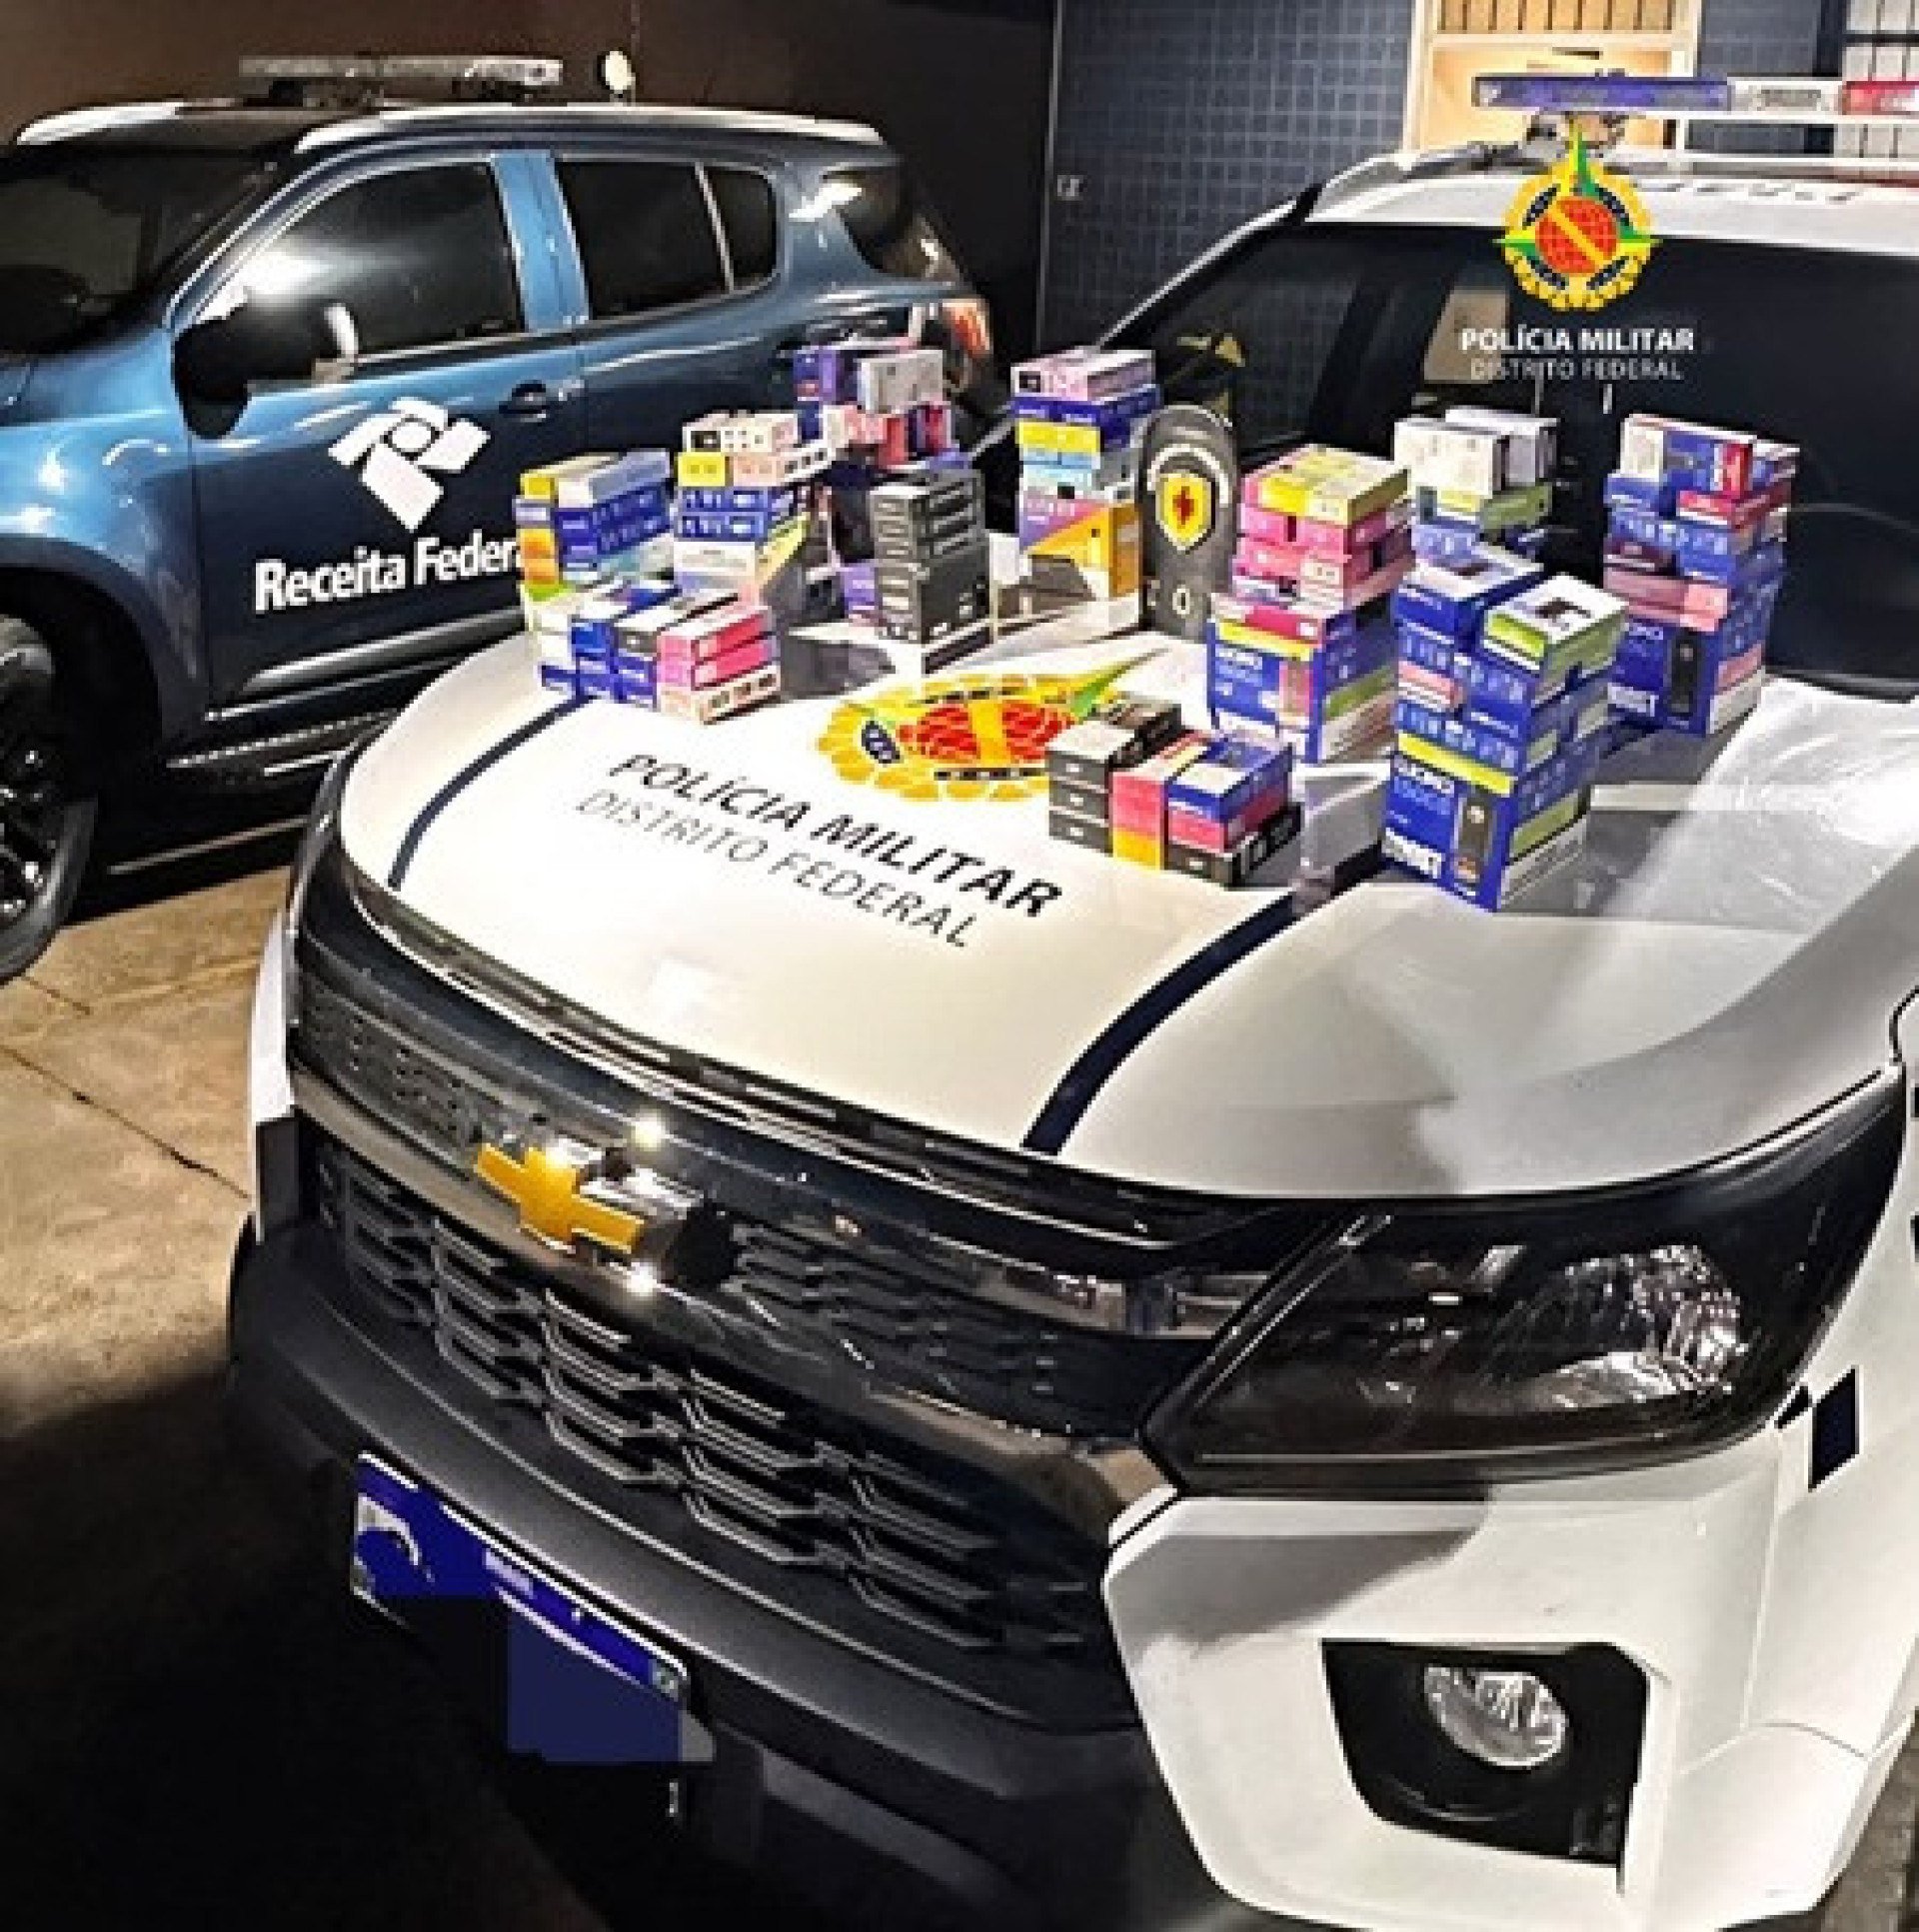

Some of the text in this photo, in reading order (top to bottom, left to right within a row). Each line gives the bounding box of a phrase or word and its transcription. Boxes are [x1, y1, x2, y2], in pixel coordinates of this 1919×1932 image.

[255, 528, 520, 615] Receita Feder
[576, 788, 977, 949] DISTRITO FEDERAL
[608, 754, 1063, 918] POLÍCIA MILITAR
